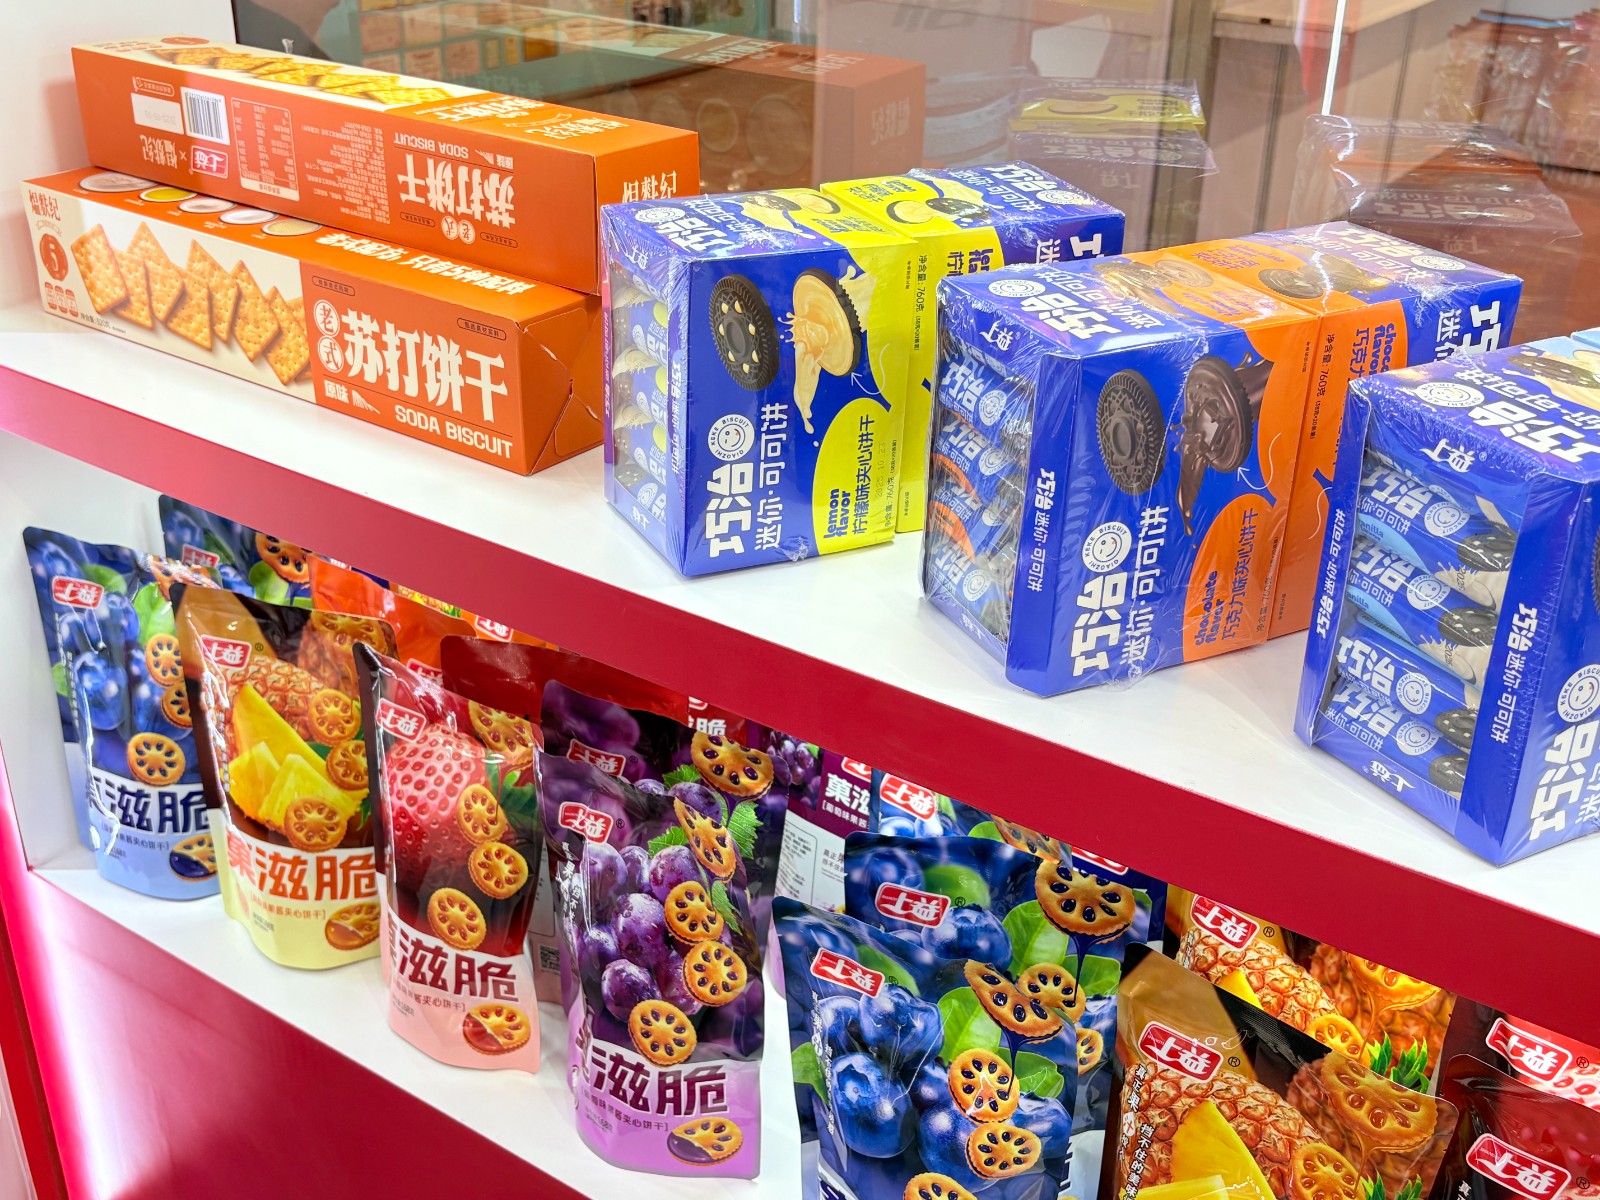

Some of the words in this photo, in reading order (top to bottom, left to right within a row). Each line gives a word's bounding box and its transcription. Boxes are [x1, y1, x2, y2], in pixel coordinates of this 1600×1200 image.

[393, 131, 436, 152] BISCUIT
[438, 142, 469, 160] SODA
[397, 153, 516, 229] 苏打饼干
[315, 232, 410, 265] 老式配方
[397, 253, 538, 296] 只有5种配料
[979, 319, 1013, 351] 上益
[341, 307, 509, 424] 苏打饼干
[323, 379, 350, 404] 原味
[395, 404, 441, 435] SODA
[445, 420, 514, 459] BISCUIT
[753, 400, 789, 551] 迷你·可可饼
[851, 412, 876, 536] 柠檬味夹心饼干
[1419, 438, 1476, 474] 上益
[822, 488, 840, 541] lemon
[837, 490, 853, 538] flavor
[1357, 494, 1411, 536] 你·可可饼
[1027, 511, 1050, 592] 迷你·可可饼
[1323, 508, 1347, 593] 迷你·可可饼
[56, 583, 99, 604] 上益
[1221, 507, 1259, 641] 巧克力味夹心饼干
[1506, 601, 1540, 655] 巧治
[211, 642, 245, 664] 上益
[1336, 635, 1396, 697] 巧治
[1490, 651, 1526, 745] 迷你·可可饼
[382, 708, 420, 735] 上益
[1370, 759, 1416, 793] 上益
[87, 776, 211, 835] 滋脆
[884, 783, 934, 817] 上益
[561, 808, 611, 840] 上益
[880, 891, 942, 922] 上益
[1191, 906, 1249, 944] 上益
[390, 914, 520, 1003] 滋脆
[820, 958, 876, 992] 上益
[585, 1036, 728, 1117] 滋脆
[1140, 1036, 1214, 1076] 上益
[1495, 1033, 1559, 1077] 上益
[1475, 1151, 1558, 1197] 上益
